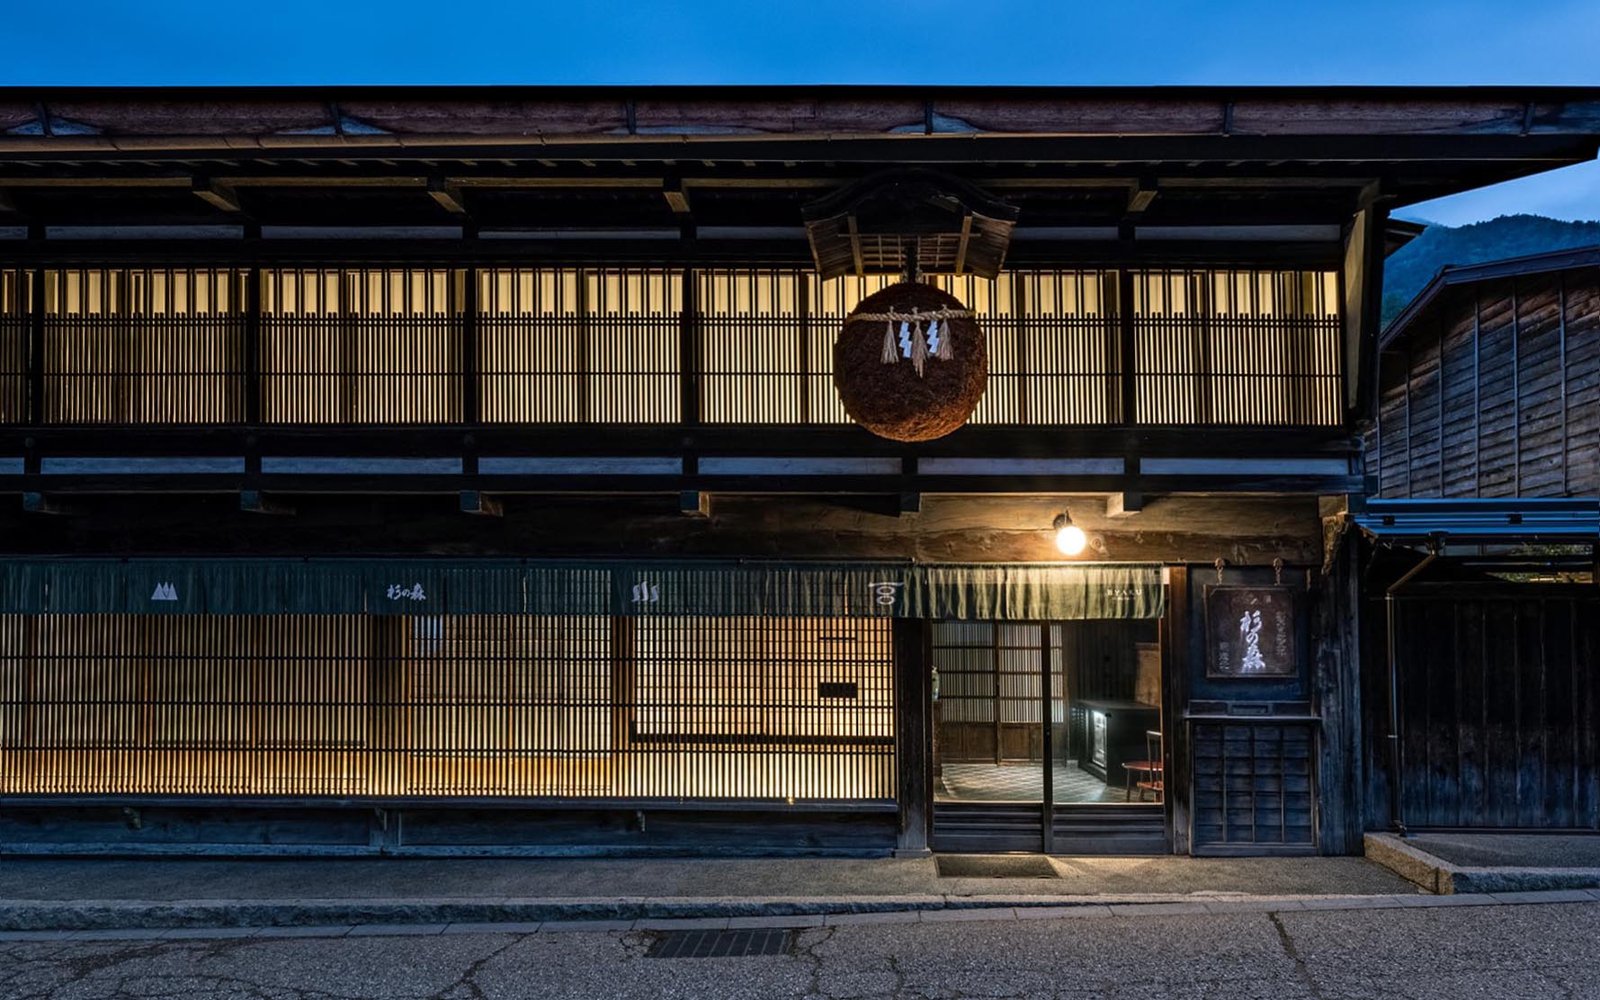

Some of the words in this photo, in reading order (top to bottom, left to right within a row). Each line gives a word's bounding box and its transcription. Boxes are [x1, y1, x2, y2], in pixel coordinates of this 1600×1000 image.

[387, 583, 426, 600] 杉の森
[1240, 610, 1266, 672] 杉の森
